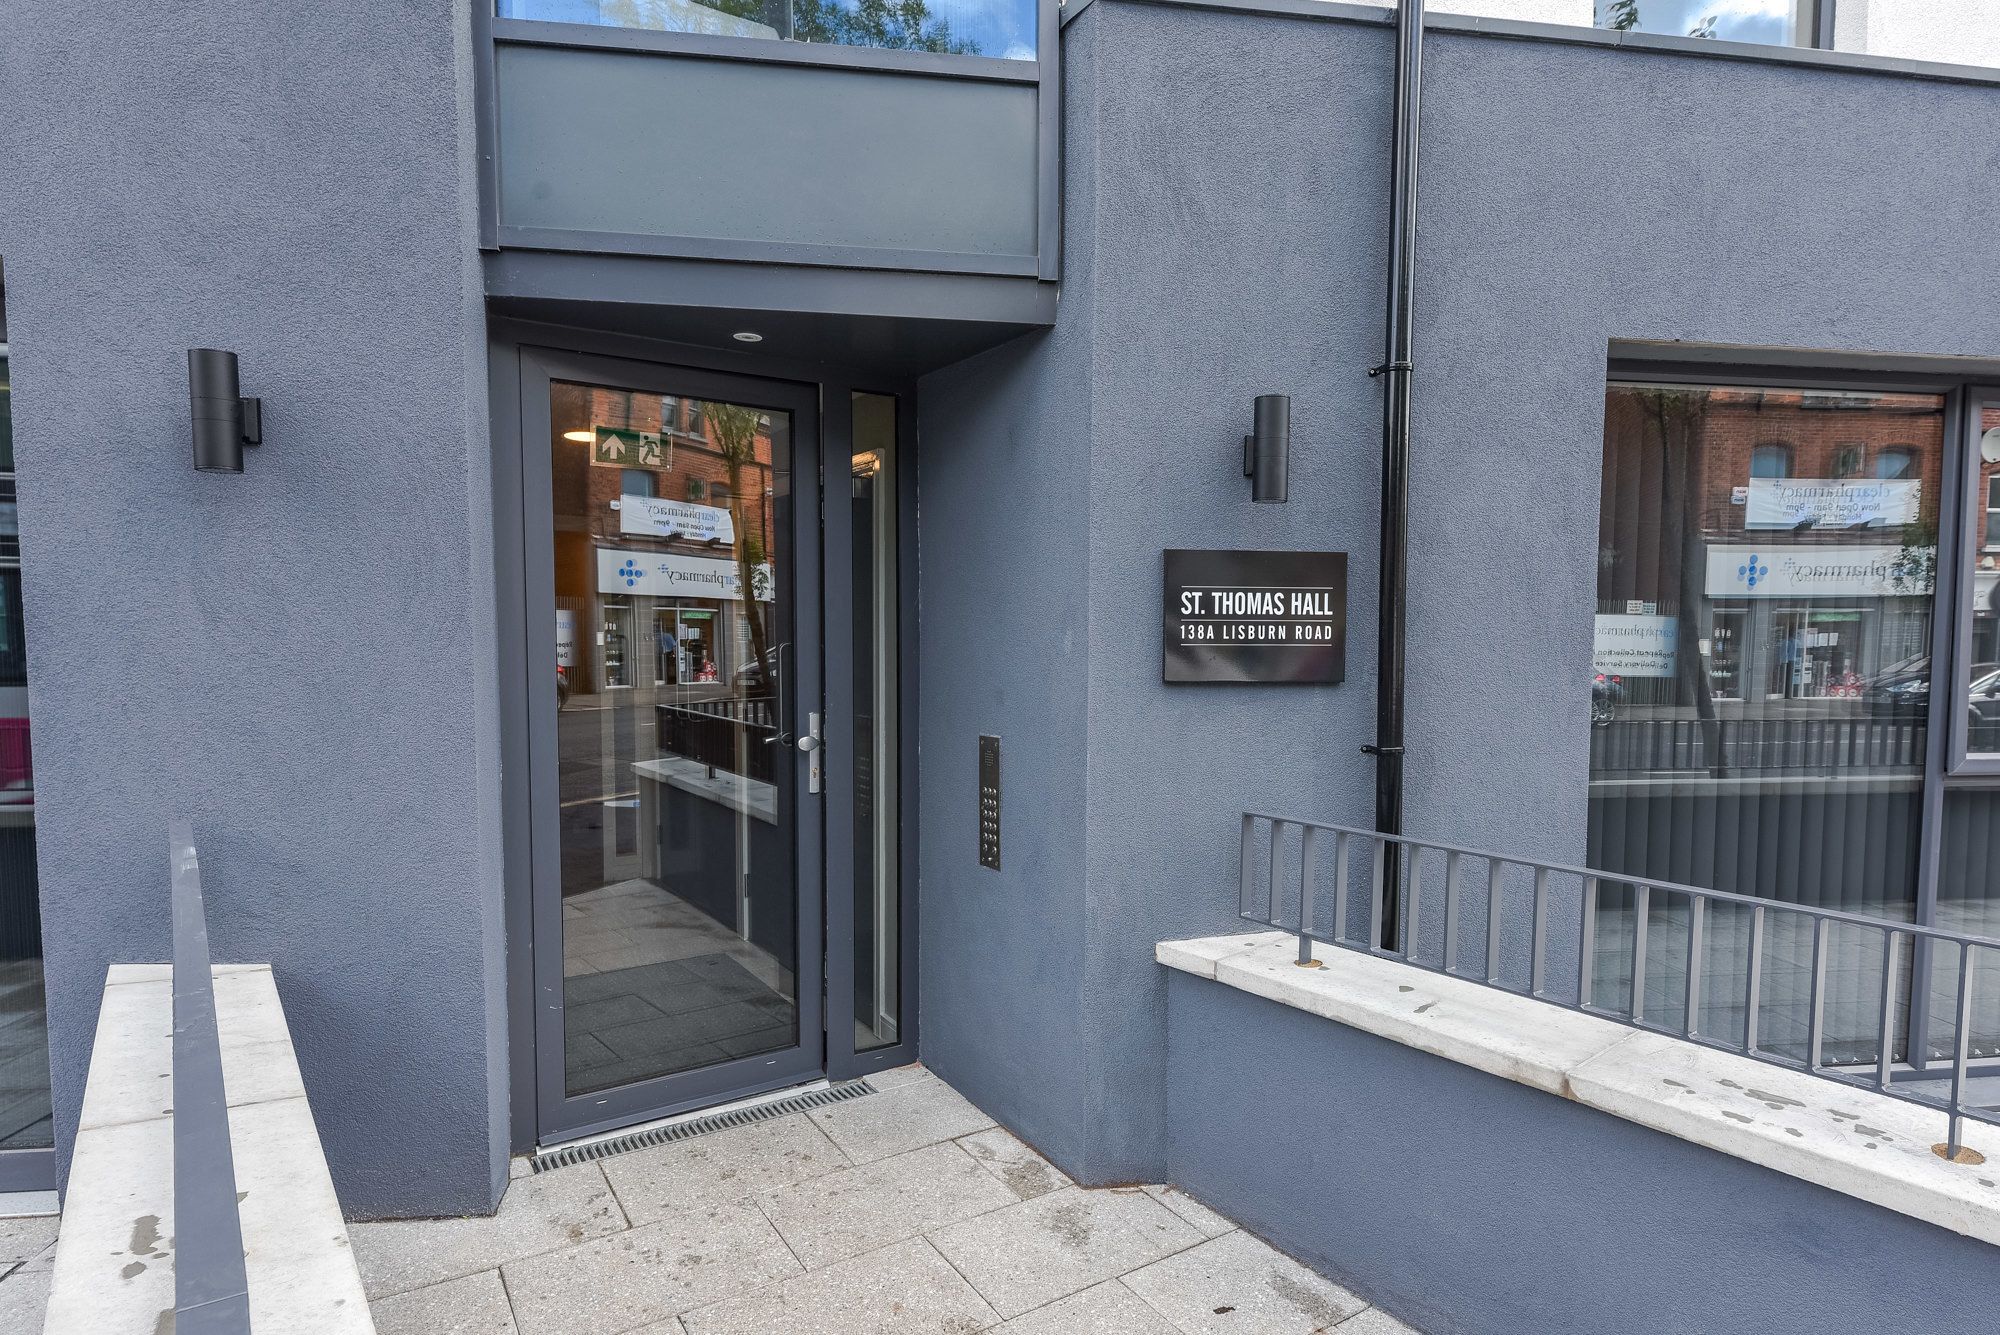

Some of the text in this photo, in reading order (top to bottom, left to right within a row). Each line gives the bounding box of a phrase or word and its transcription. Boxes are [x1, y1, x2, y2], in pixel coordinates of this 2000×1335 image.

[1180, 591, 1333, 616] ST. THOMAS HALL
[1180, 624, 1332, 640] 138A LISBURN ROAD
